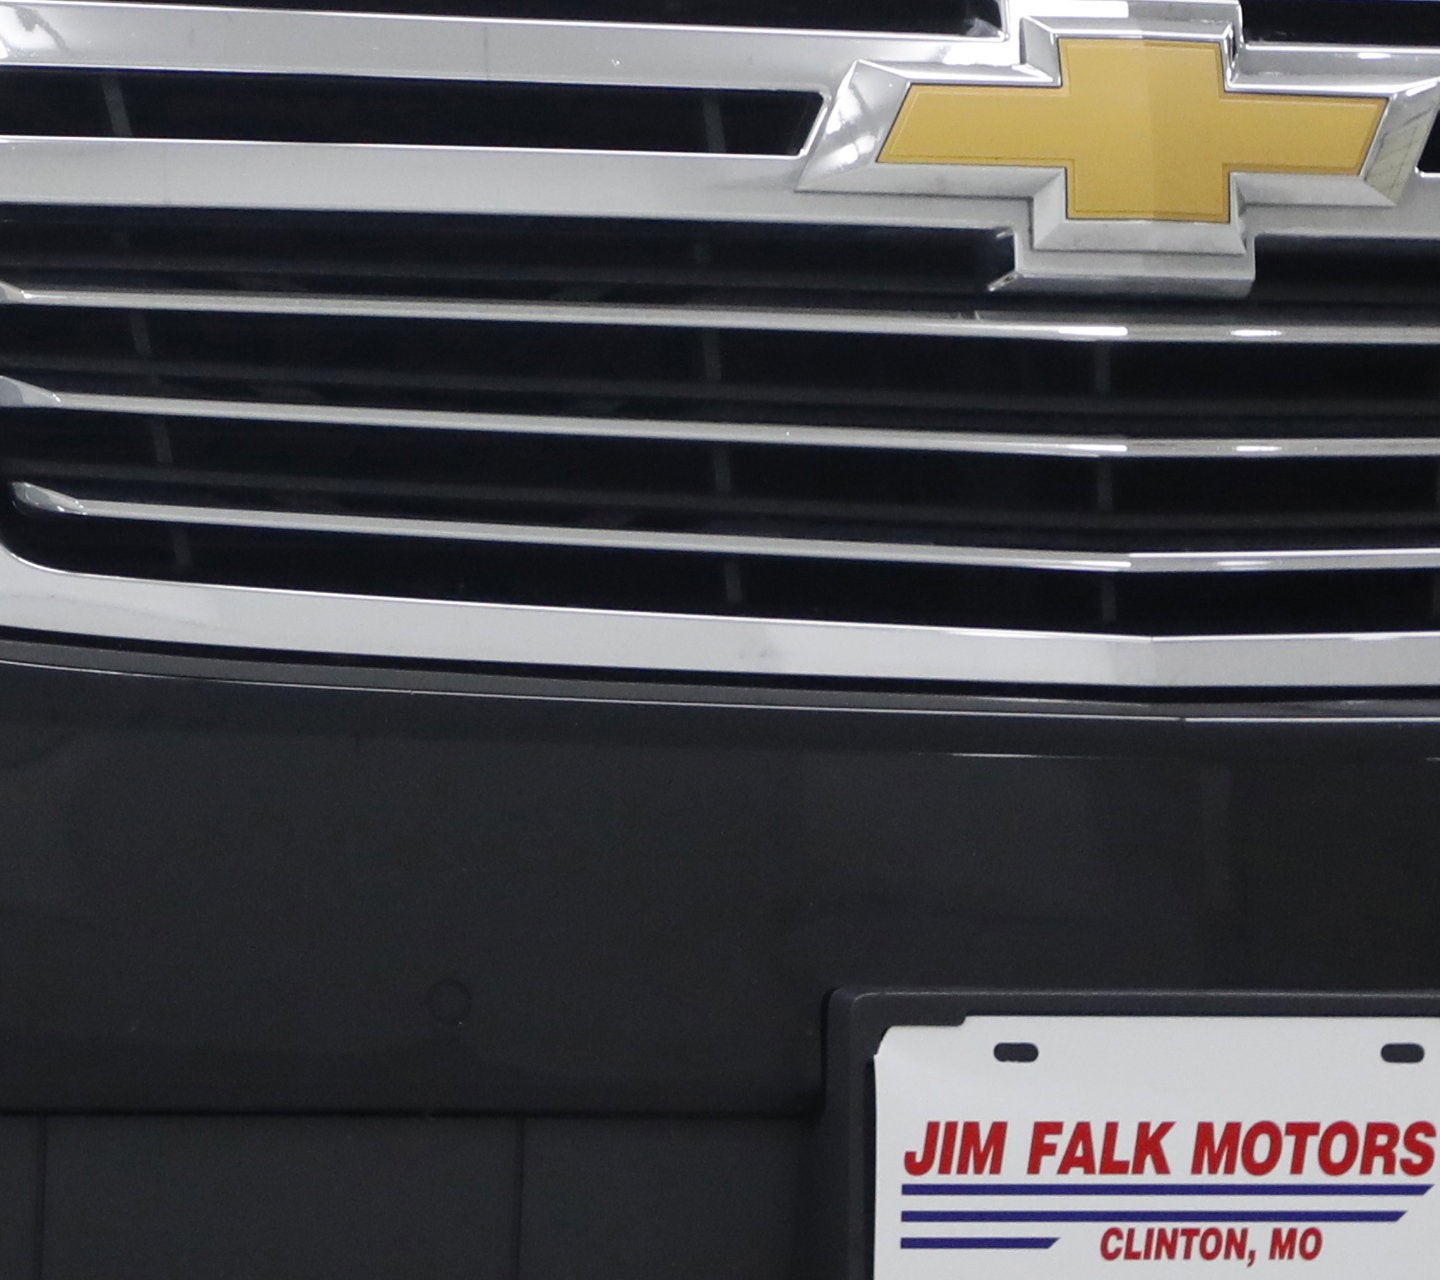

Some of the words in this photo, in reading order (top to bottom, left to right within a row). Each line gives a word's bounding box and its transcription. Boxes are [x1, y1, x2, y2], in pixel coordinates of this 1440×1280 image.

[903, 1120, 1008, 1177] JIM
[1027, 1121, 1176, 1176] FALK
[1191, 1120, 1438, 1177] MOTORS
[1100, 1227, 1257, 1267] CLINTON,
[1269, 1227, 1324, 1261] MO
